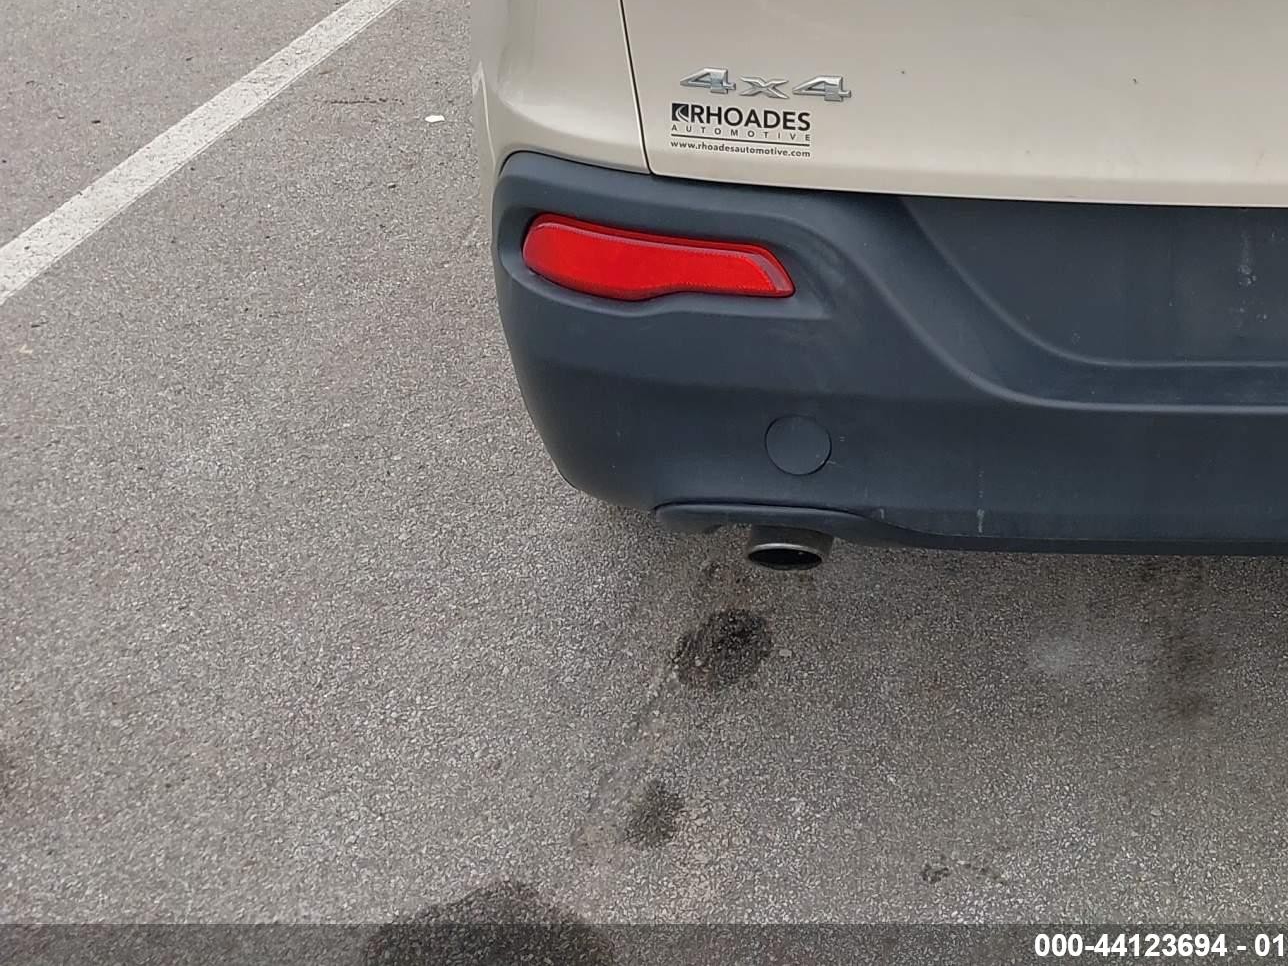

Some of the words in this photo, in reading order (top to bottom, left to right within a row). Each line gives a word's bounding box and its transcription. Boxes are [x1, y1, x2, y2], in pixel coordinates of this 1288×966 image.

[690, 103, 811, 131] RHOADES
[671, 124, 811, 142] AUTOMOTIVE
[670, 140, 811, 158] www.rhoadesautomotive.com
